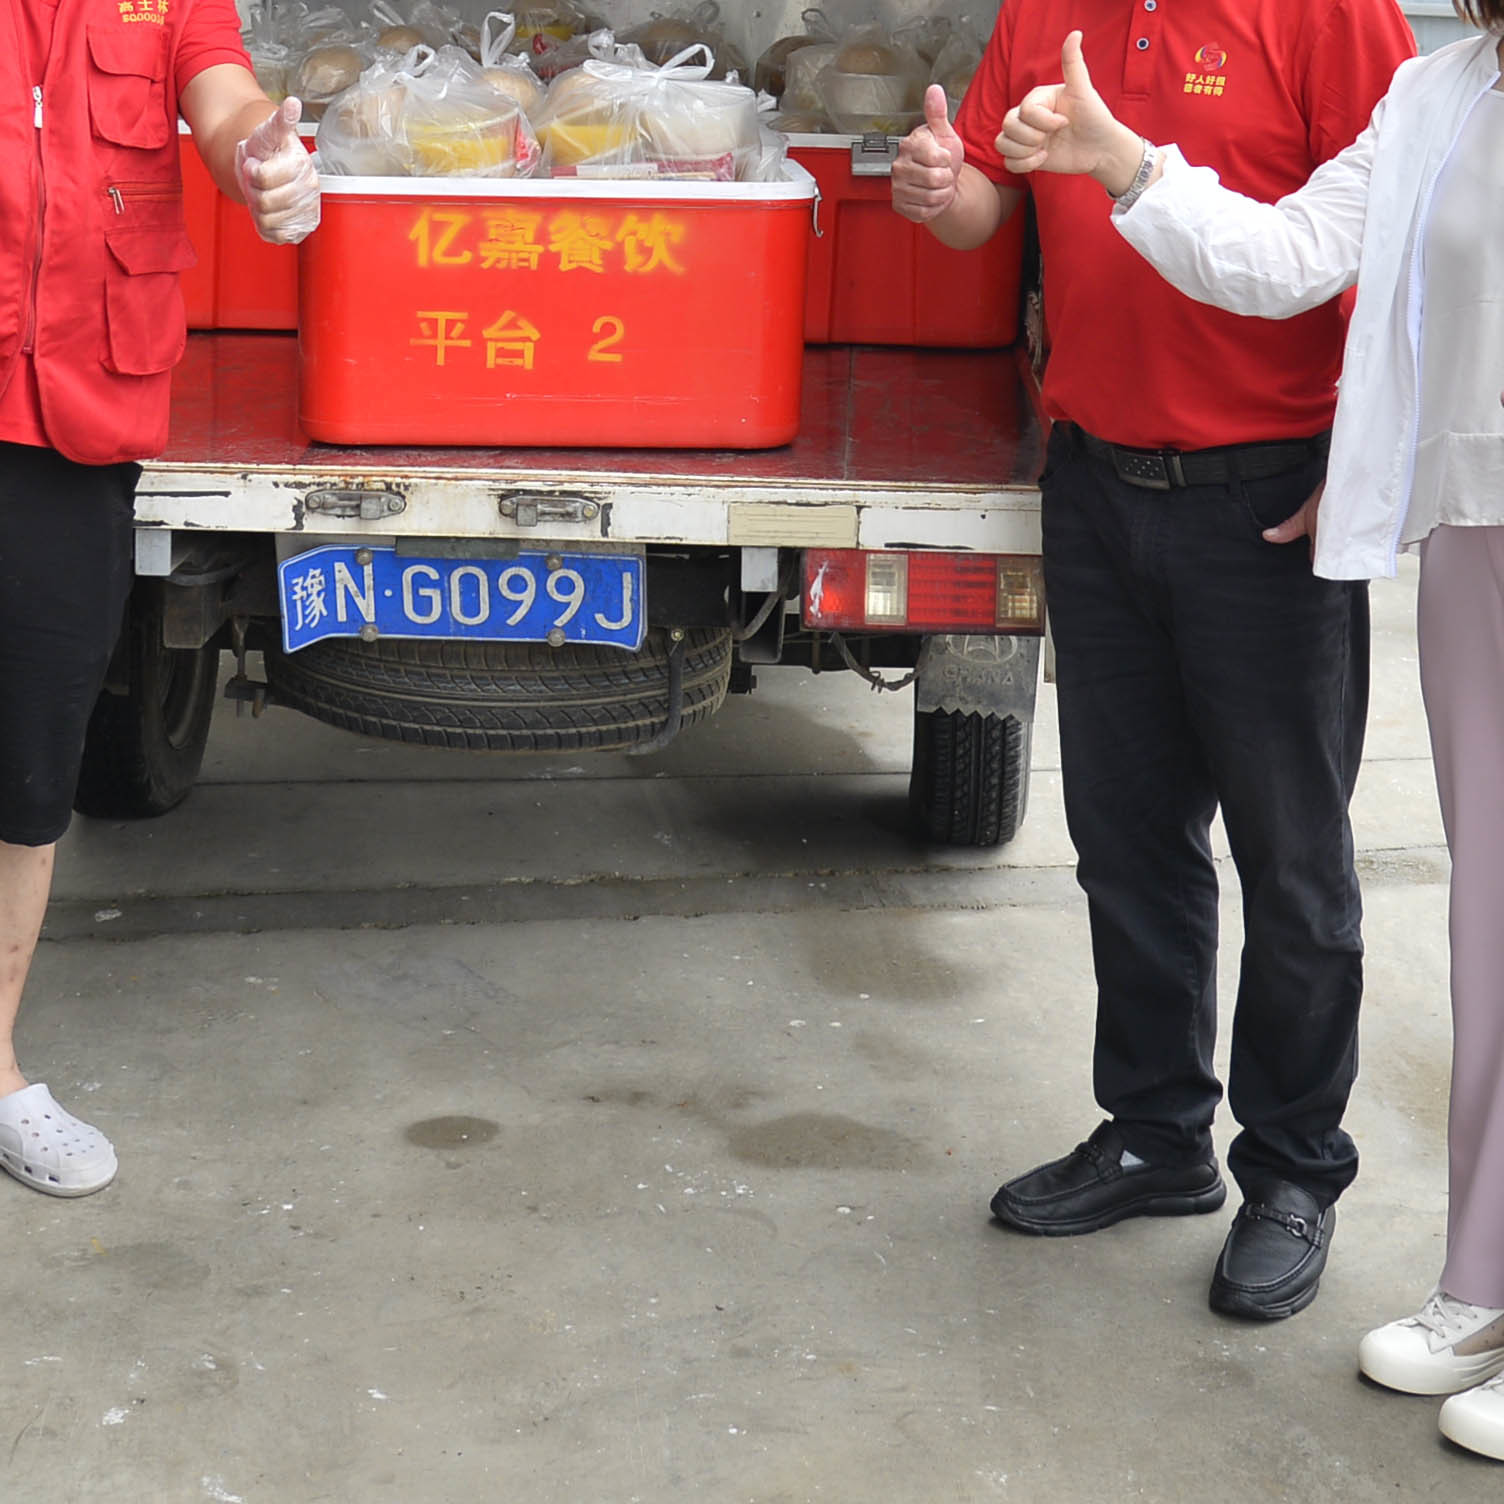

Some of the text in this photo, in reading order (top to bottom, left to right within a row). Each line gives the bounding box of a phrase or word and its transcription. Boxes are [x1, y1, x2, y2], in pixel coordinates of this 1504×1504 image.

[409, 207, 684, 274] 亿嘉餐饮
[410, 311, 625, 370] 平台 2
